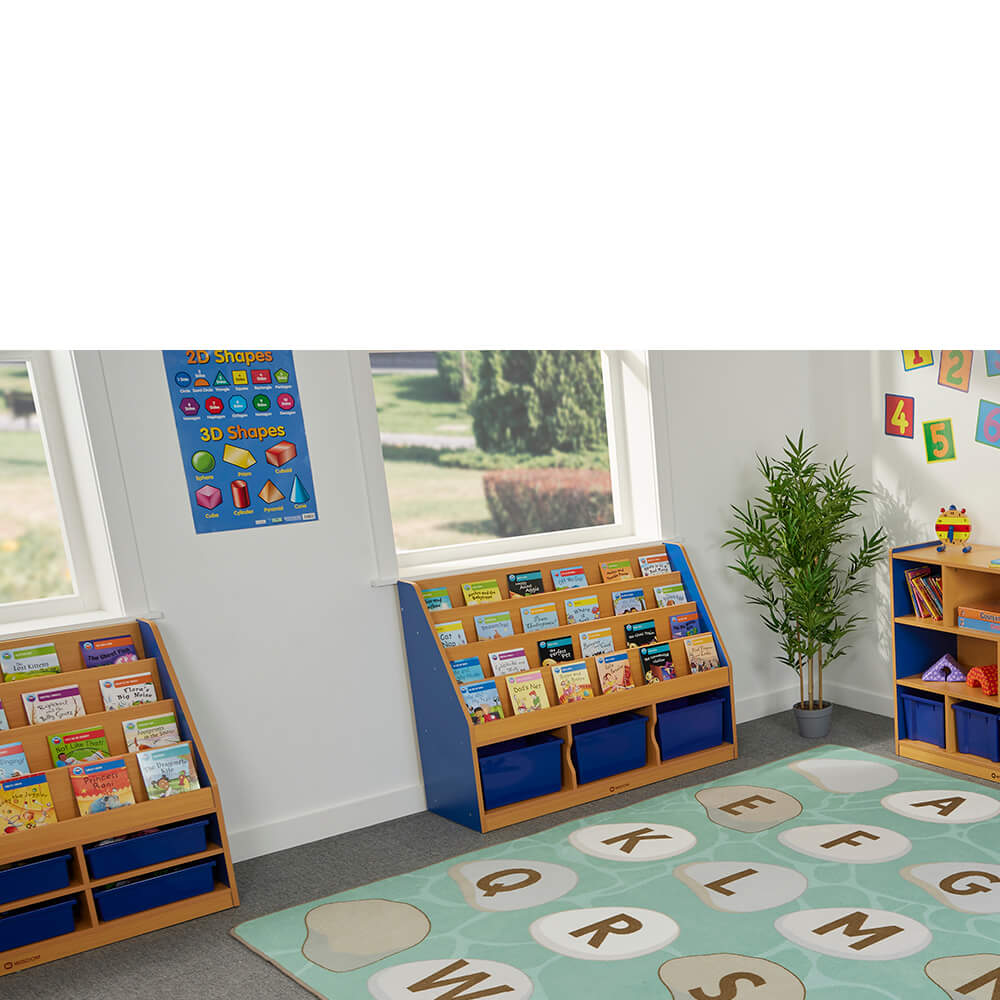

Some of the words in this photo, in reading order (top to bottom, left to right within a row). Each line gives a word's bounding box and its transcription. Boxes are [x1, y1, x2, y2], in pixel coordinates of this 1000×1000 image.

[186, 350, 210, 364] 2D
[214, 350, 274, 366] Shapes
[946, 350, 964, 385] 2
[891, 400, 909, 434] 4
[200, 427, 224, 442] 3D
[227, 425, 286, 441] Shapes
[930, 423, 949, 458] 5
[719, 794, 777, 816] E
[911, 796, 967, 817] A
[601, 827, 673, 854] K
[820, 830, 881, 849] F
[476, 868, 542, 897] Q
[703, 868, 758, 897] L
[939, 870, 1000, 896] G
[568, 913, 643, 949] R
[811, 911, 905, 951] M
